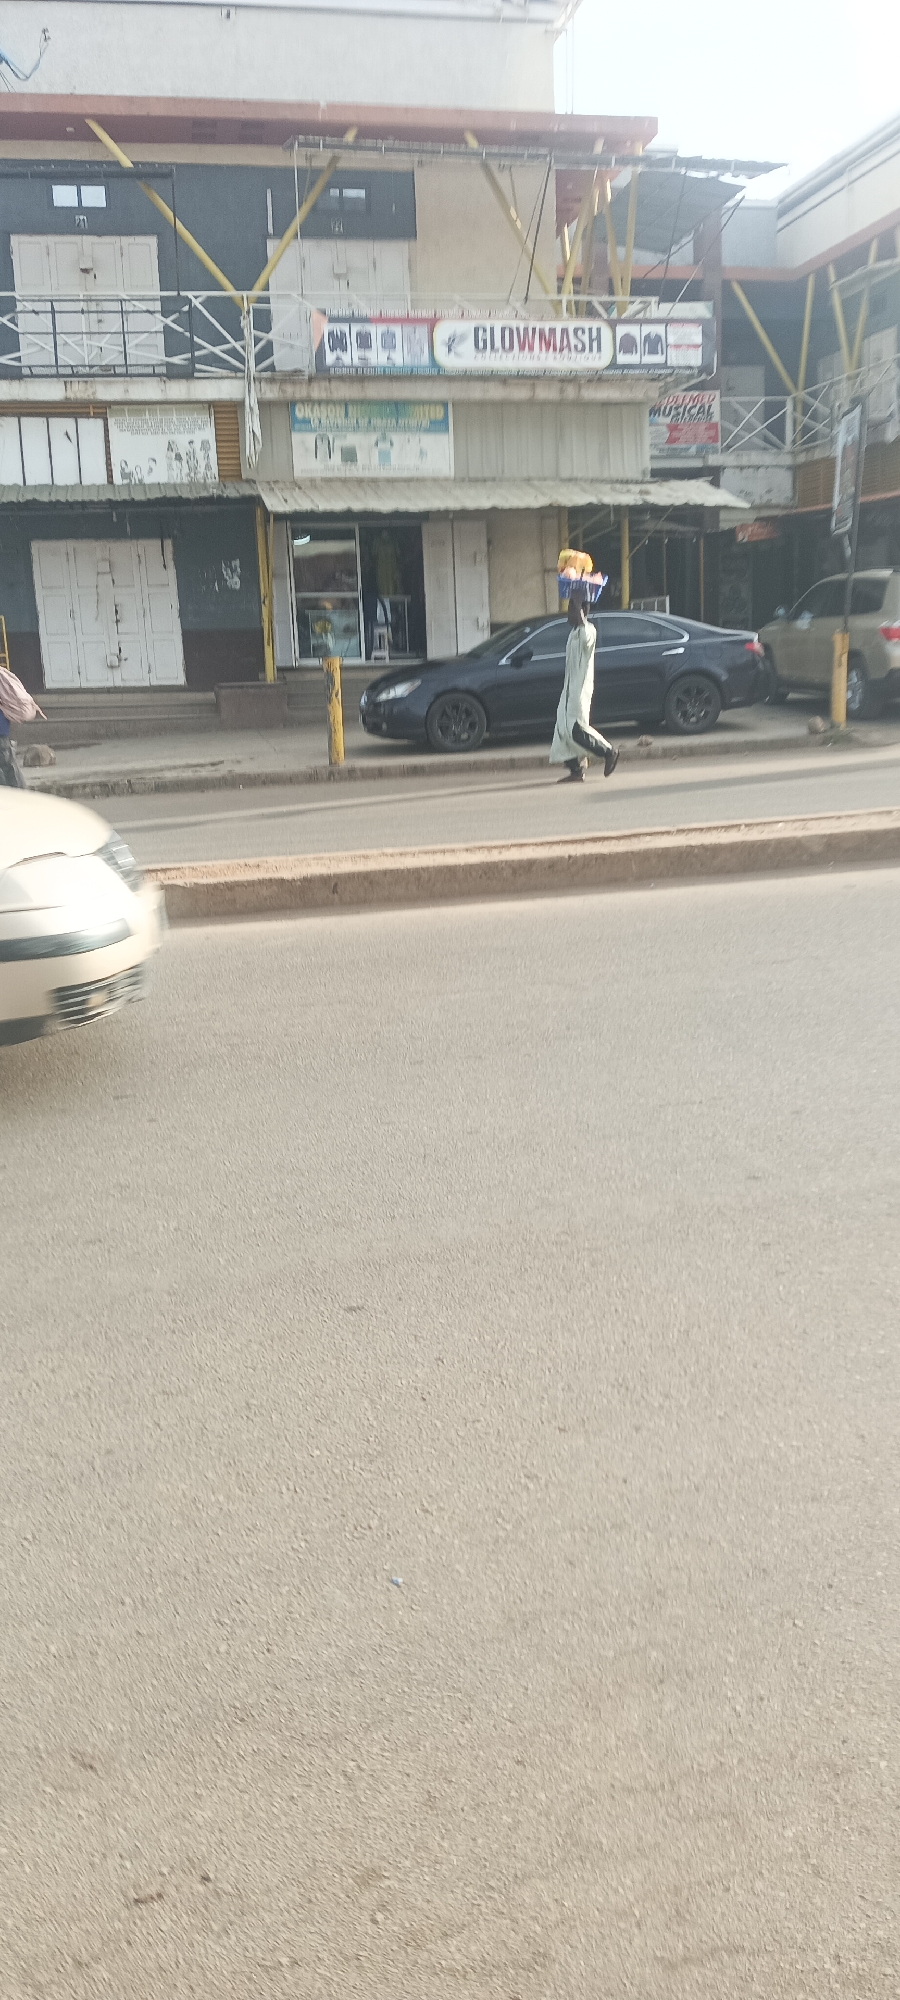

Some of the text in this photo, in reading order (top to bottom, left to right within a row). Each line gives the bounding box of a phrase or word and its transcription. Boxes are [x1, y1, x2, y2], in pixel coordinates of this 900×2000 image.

[474, 326, 602, 353] GLOWMASH
[295, 402, 345, 419] OKASON
[649, 404, 713, 419] MUSICAL
